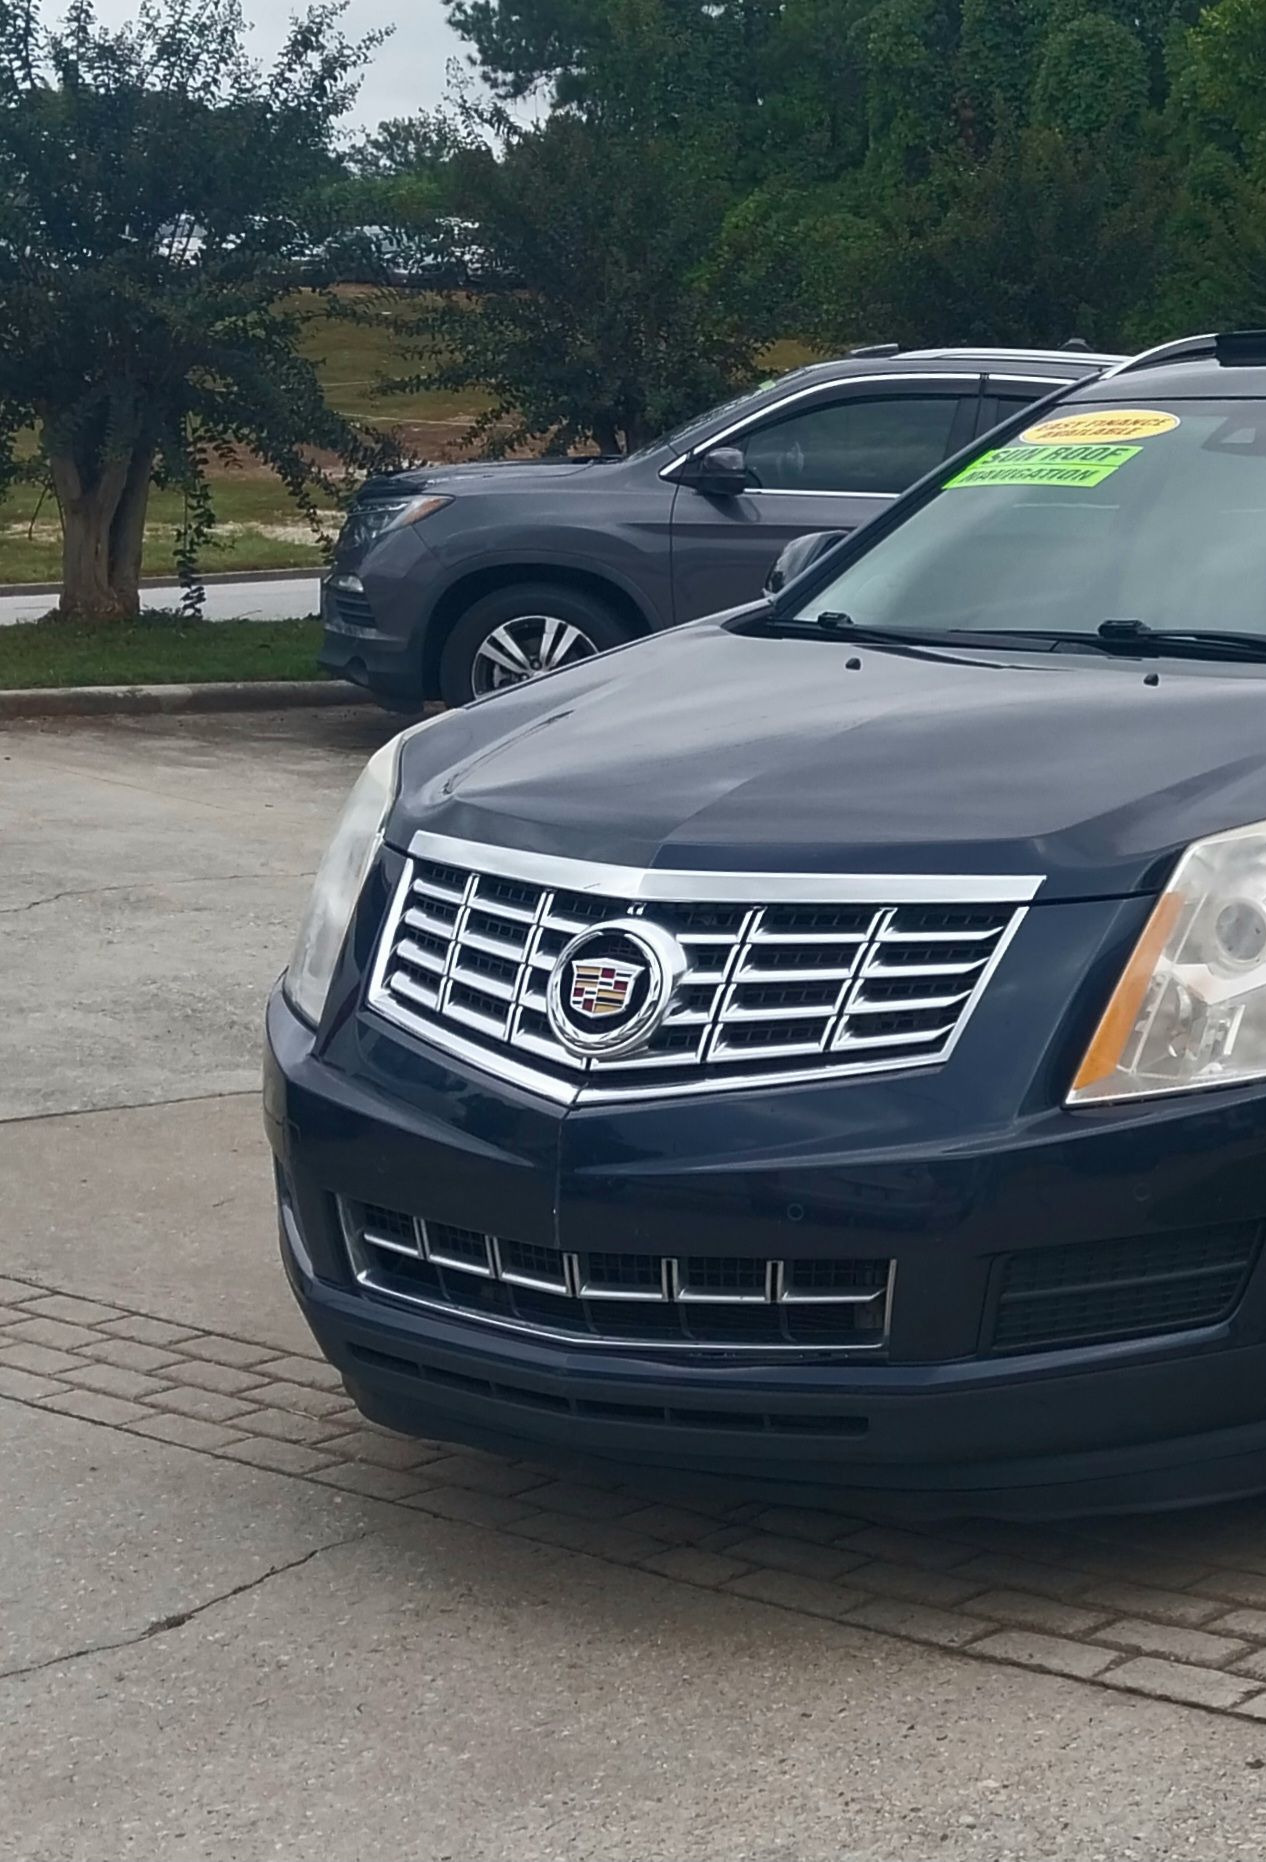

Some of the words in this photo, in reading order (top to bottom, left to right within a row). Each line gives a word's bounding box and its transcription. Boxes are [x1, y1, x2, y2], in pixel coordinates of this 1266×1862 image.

[982, 448, 1047, 464] SUN
[1042, 446, 1130, 462] ROOF
[959, 467, 1100, 483] NAVIGATION
